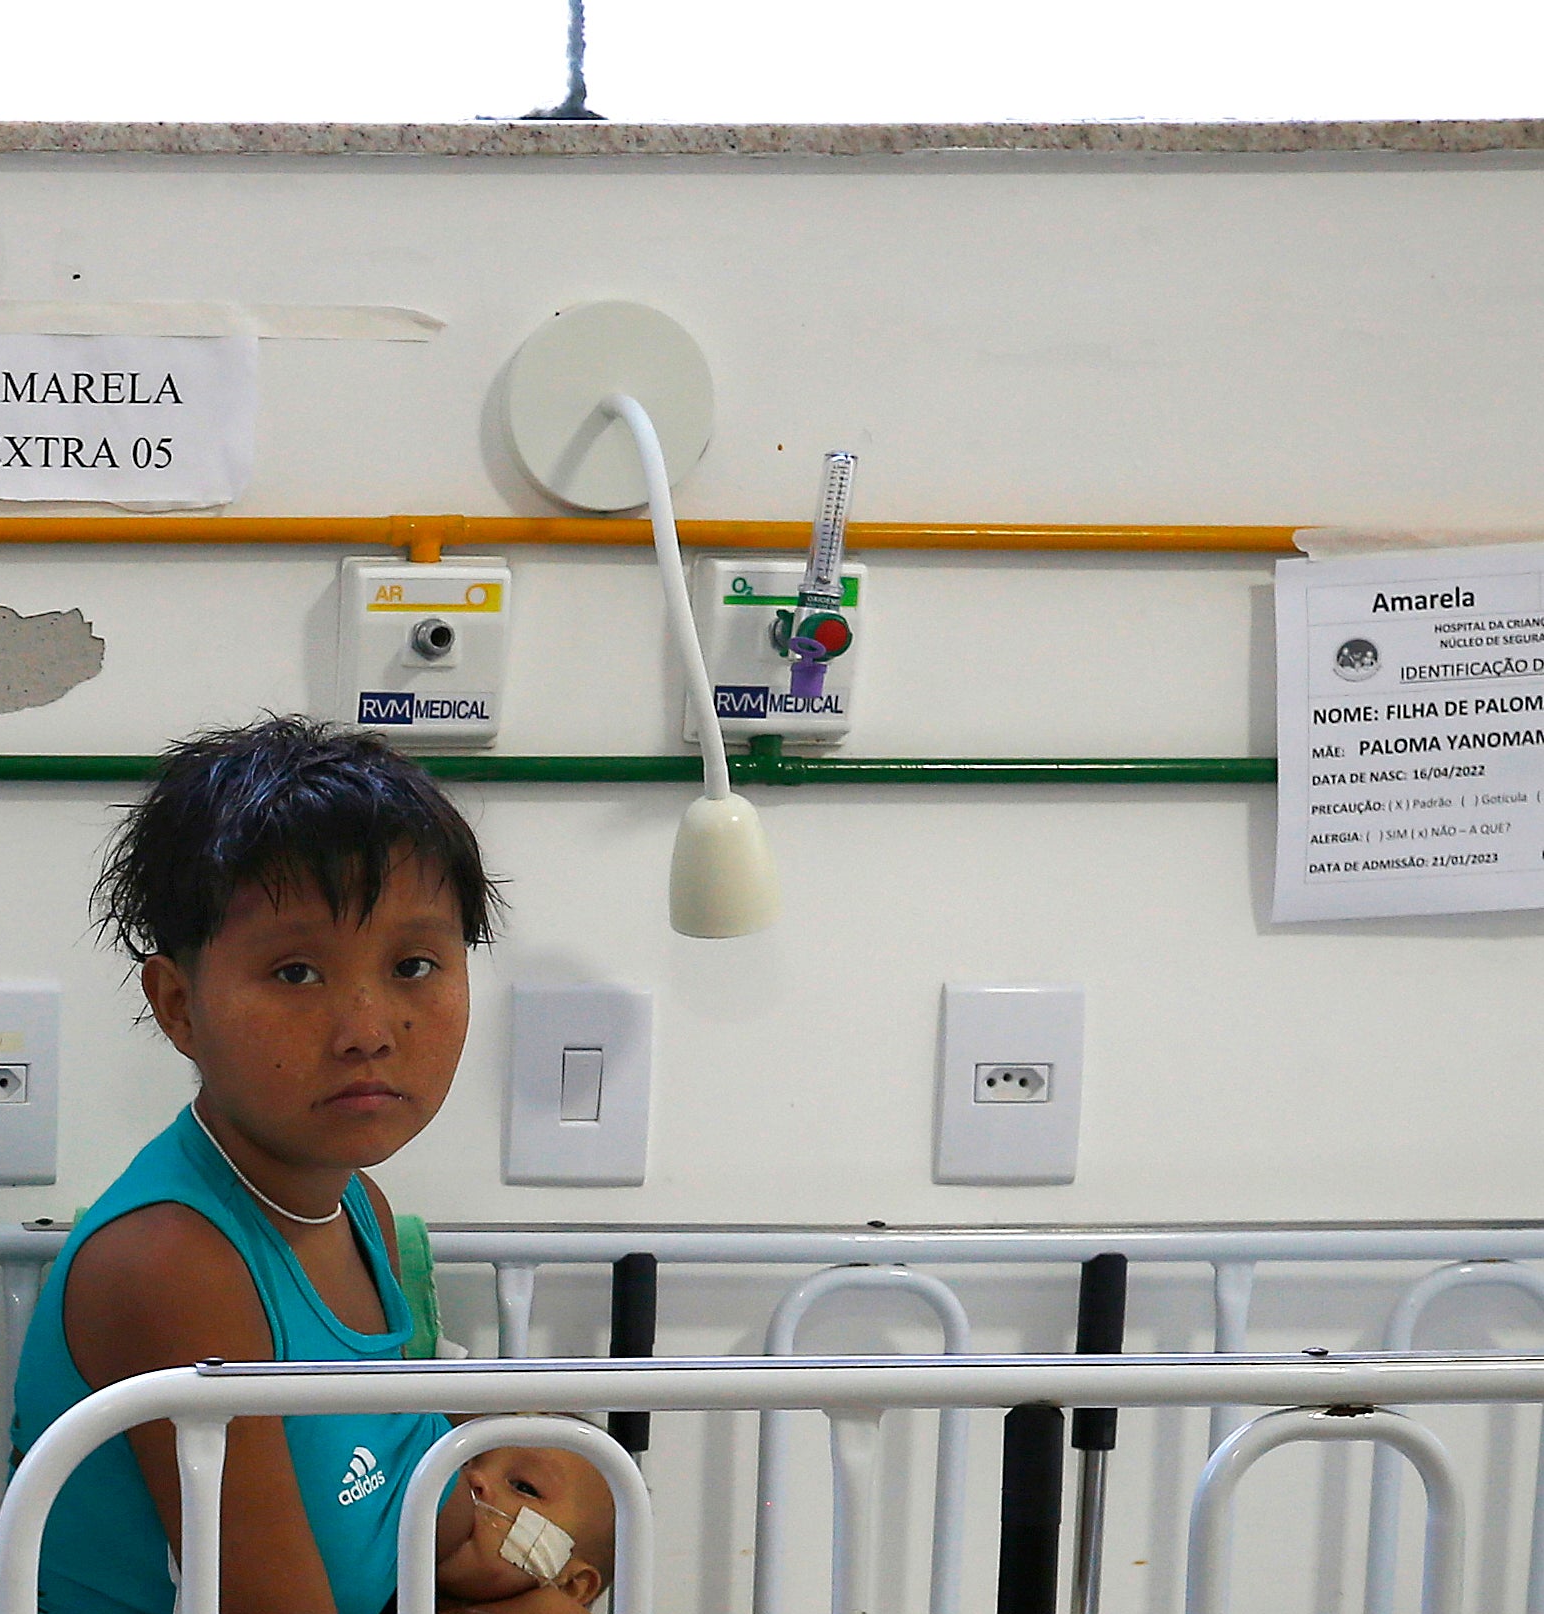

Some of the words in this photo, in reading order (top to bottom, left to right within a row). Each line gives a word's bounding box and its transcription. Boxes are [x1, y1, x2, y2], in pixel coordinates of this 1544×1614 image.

[132, 437, 173, 469] 05
[375, 585, 403, 602] AR
[1372, 586, 1475, 614] Amarela
[1434, 622, 1486, 634] HOSPITAL
[1488, 620, 1506, 630] DA
[1440, 637, 1483, 649] NÚCLEO
[1485, 636, 1500, 646] DE
[1400, 658, 1528, 681] IDENTIFICAÇÃO
[363, 699, 411, 718] RVM
[415, 700, 490, 720] MEDICAL
[717, 692, 764, 712] RVM
[769, 694, 844, 714] MEDICAL
[1313, 706, 1379, 725] NOME:
[1386, 703, 1439, 721] FILHA
[1445, 700, 1469, 717] DE
[1312, 745, 1345, 759] MÃE:
[1359, 736, 1441, 756] PALOMA
[1312, 773, 1346, 786] DATA
[1350, 772, 1366, 784] DE
[1369, 770, 1408, 782] NASC:
[1413, 765, 1486, 781] 16/04/2022
[1311, 800, 1385, 816] PRECAUÇÃO:
[1413, 797, 1452, 810] Padrão
[1311, 832, 1362, 845] ALERGIA:
[1385, 828, 1408, 841] SIM
[1430, 824, 1457, 838] NÃO
[1479, 822, 1511, 836] QUE?
[1309, 861, 1341, 874] DATA
[1344, 861, 1360, 872] DE
[1362, 856, 1429, 871] ADMISSÃO:
[1431, 853, 1499, 867] 21/01/2023
[338, 1470, 386, 1505] adidas
